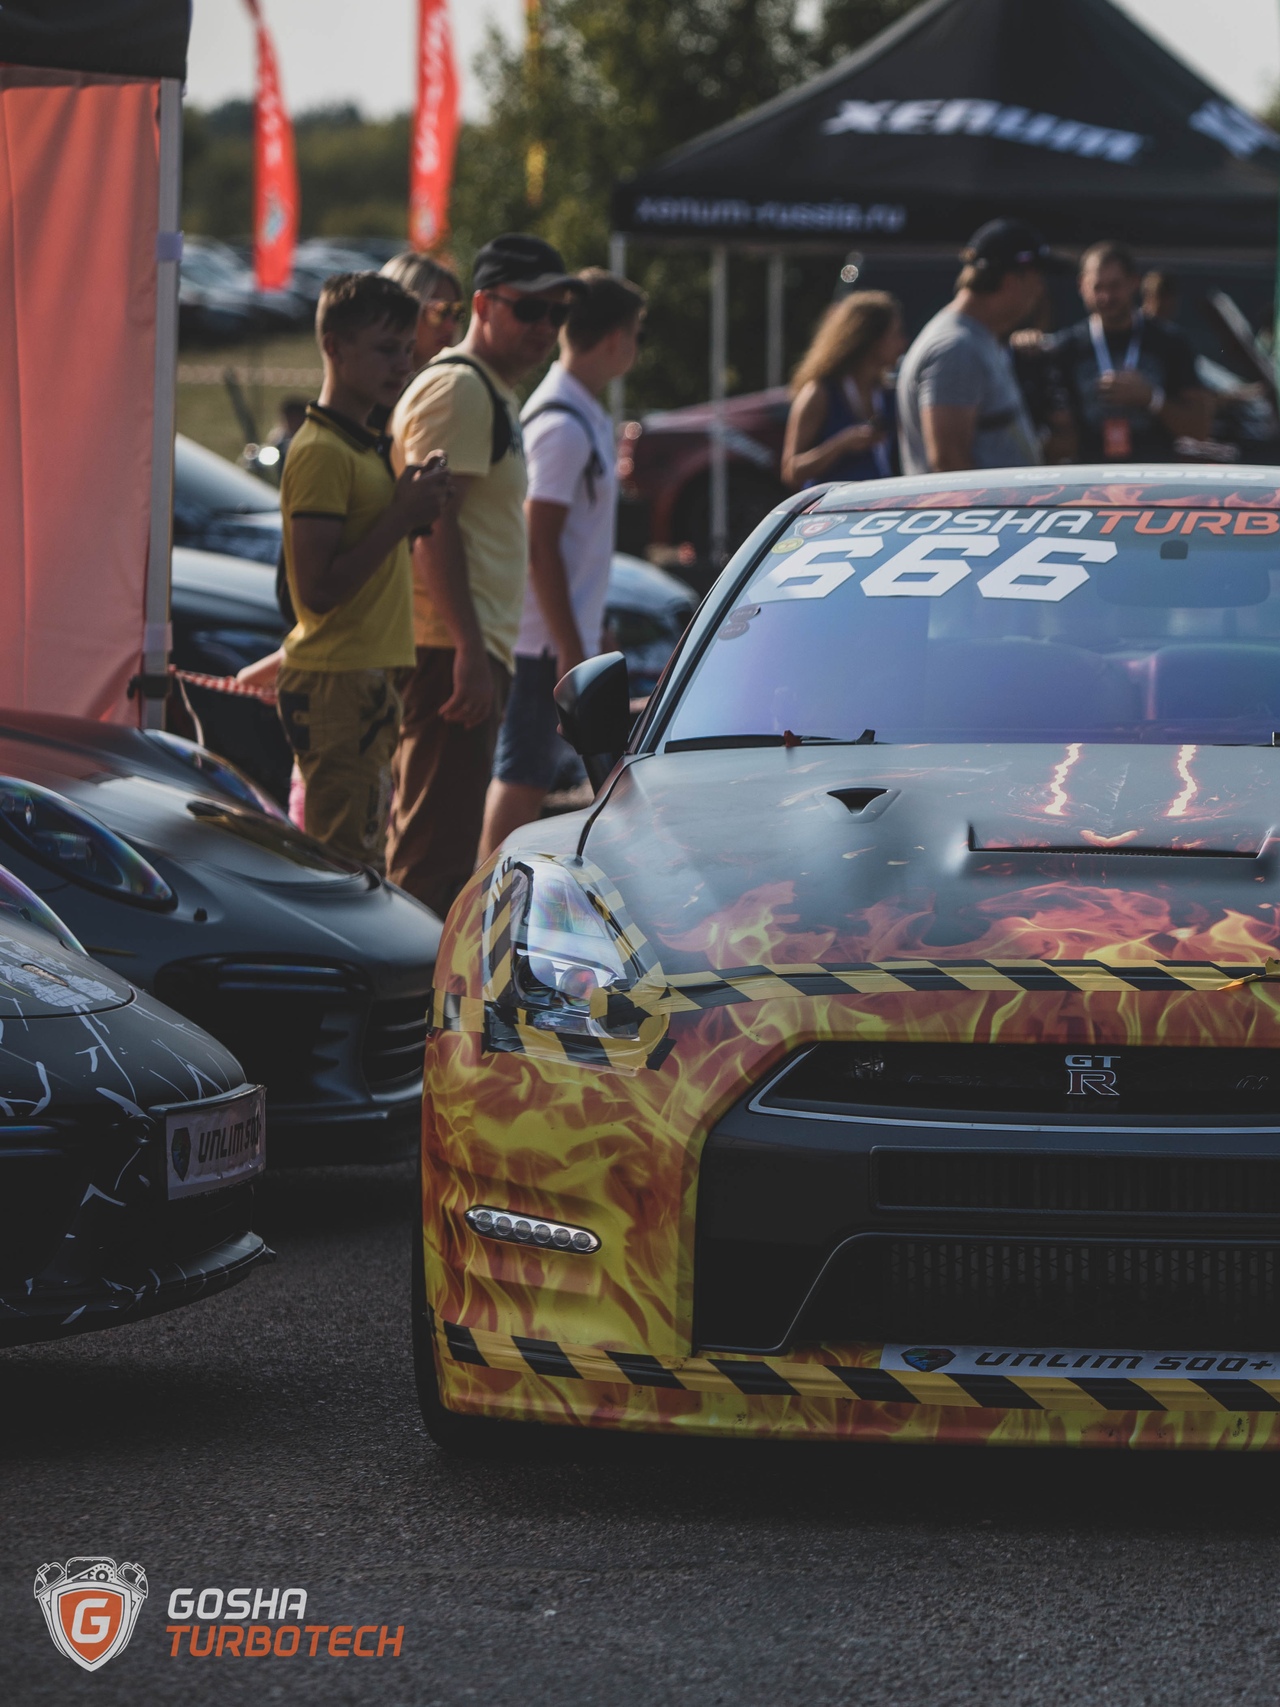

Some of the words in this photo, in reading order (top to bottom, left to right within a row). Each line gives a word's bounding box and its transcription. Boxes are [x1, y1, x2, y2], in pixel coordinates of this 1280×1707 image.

[757, 534, 1118, 603] 666
[1065, 1054, 1121, 1068] GT
[1066, 1069, 1120, 1095] R
[198, 1122, 244, 1163] UNLIM
[974, 1352, 1142, 1370] UNLIM
[1153, 1356, 1273, 1372] 500+
